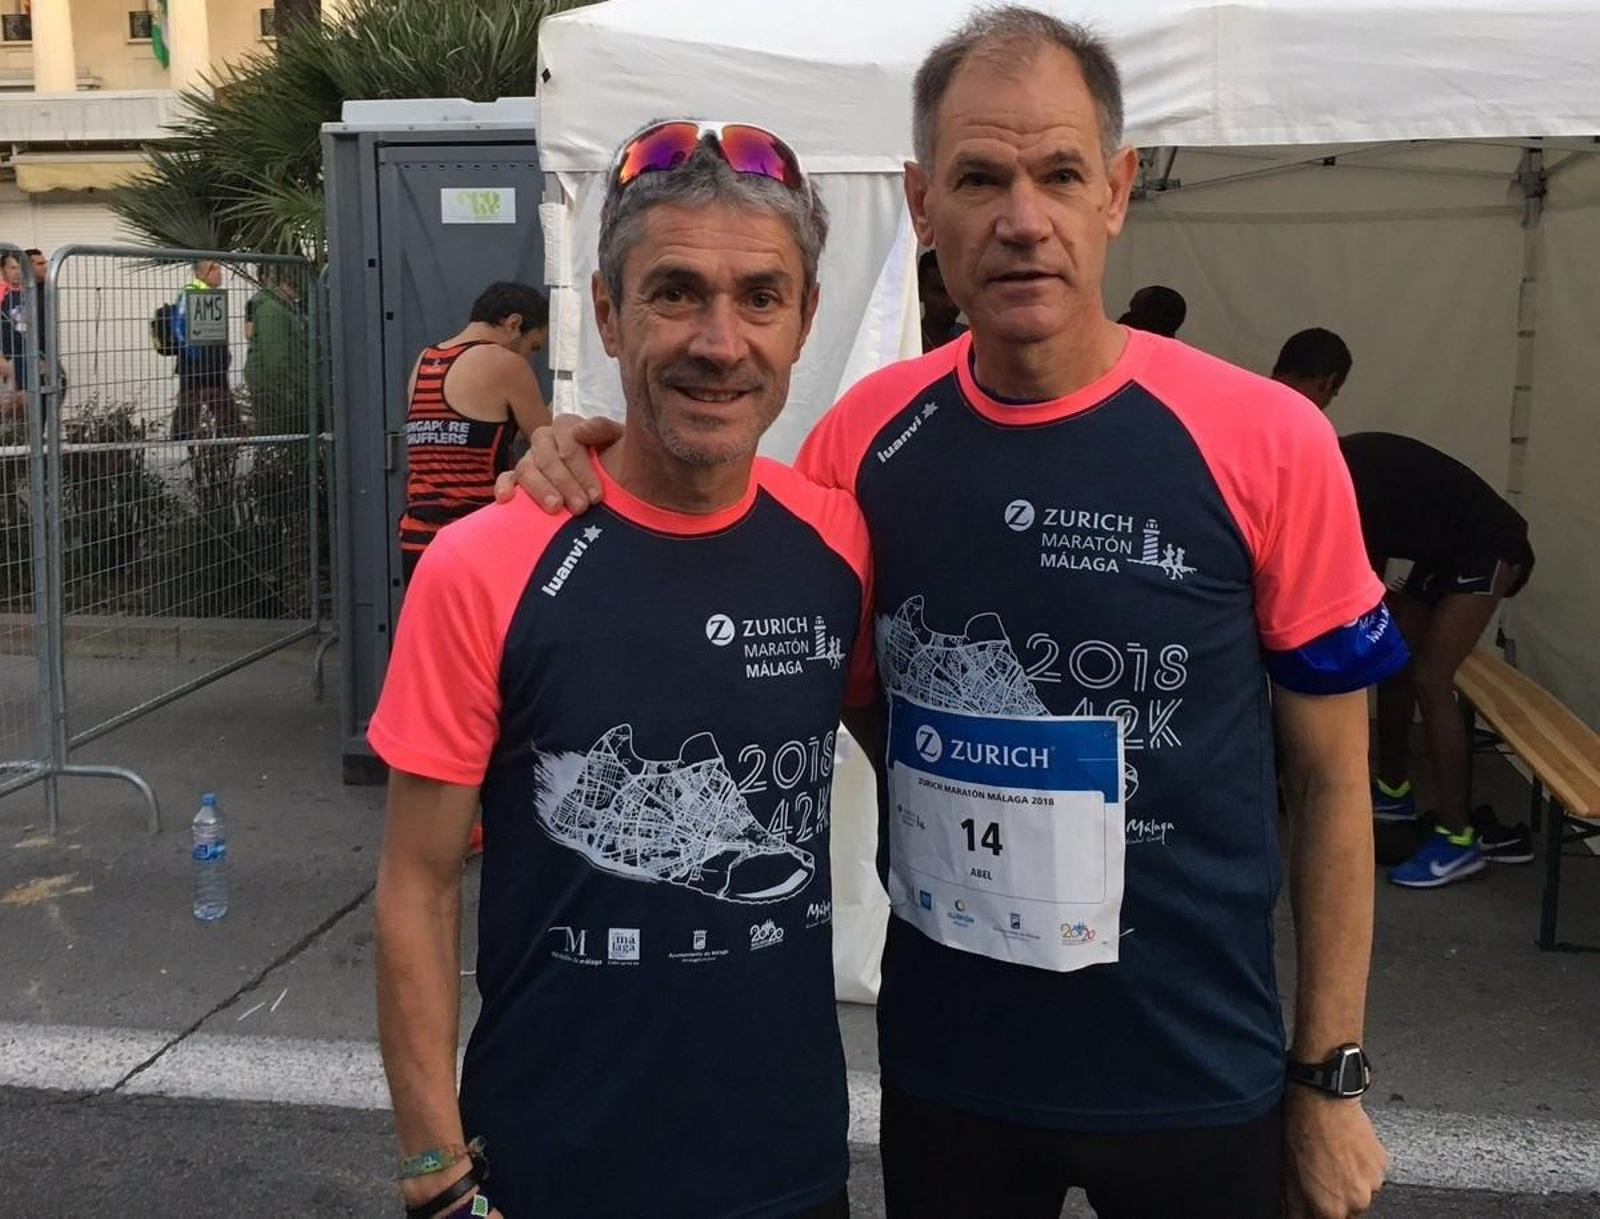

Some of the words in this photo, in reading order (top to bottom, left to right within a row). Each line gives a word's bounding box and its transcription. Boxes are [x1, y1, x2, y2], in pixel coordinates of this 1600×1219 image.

[194, 296, 222, 321] AMS
[877, 415, 922, 463] luanvi
[1043, 509, 1133, 533] ZURICH
[1041, 533, 1132, 554] MARATÓN
[541, 538, 588, 597] luanvi
[1040, 552, 1120, 573] MÁLAGA
[742, 617, 808, 637] ZURICH
[744, 638, 809, 658] MARATÓN
[746, 660, 804, 678] MÁLAGA
[951, 739, 1049, 769] ZURICH
[944, 783, 986, 799] MARATÓN
[987, 790, 1029, 804] MÁLAGA
[1031, 797, 1055, 806] 2018
[960, 818, 1003, 856] 14
[970, 867, 993, 881] ABEL
[750, 924, 784, 942] 2020
